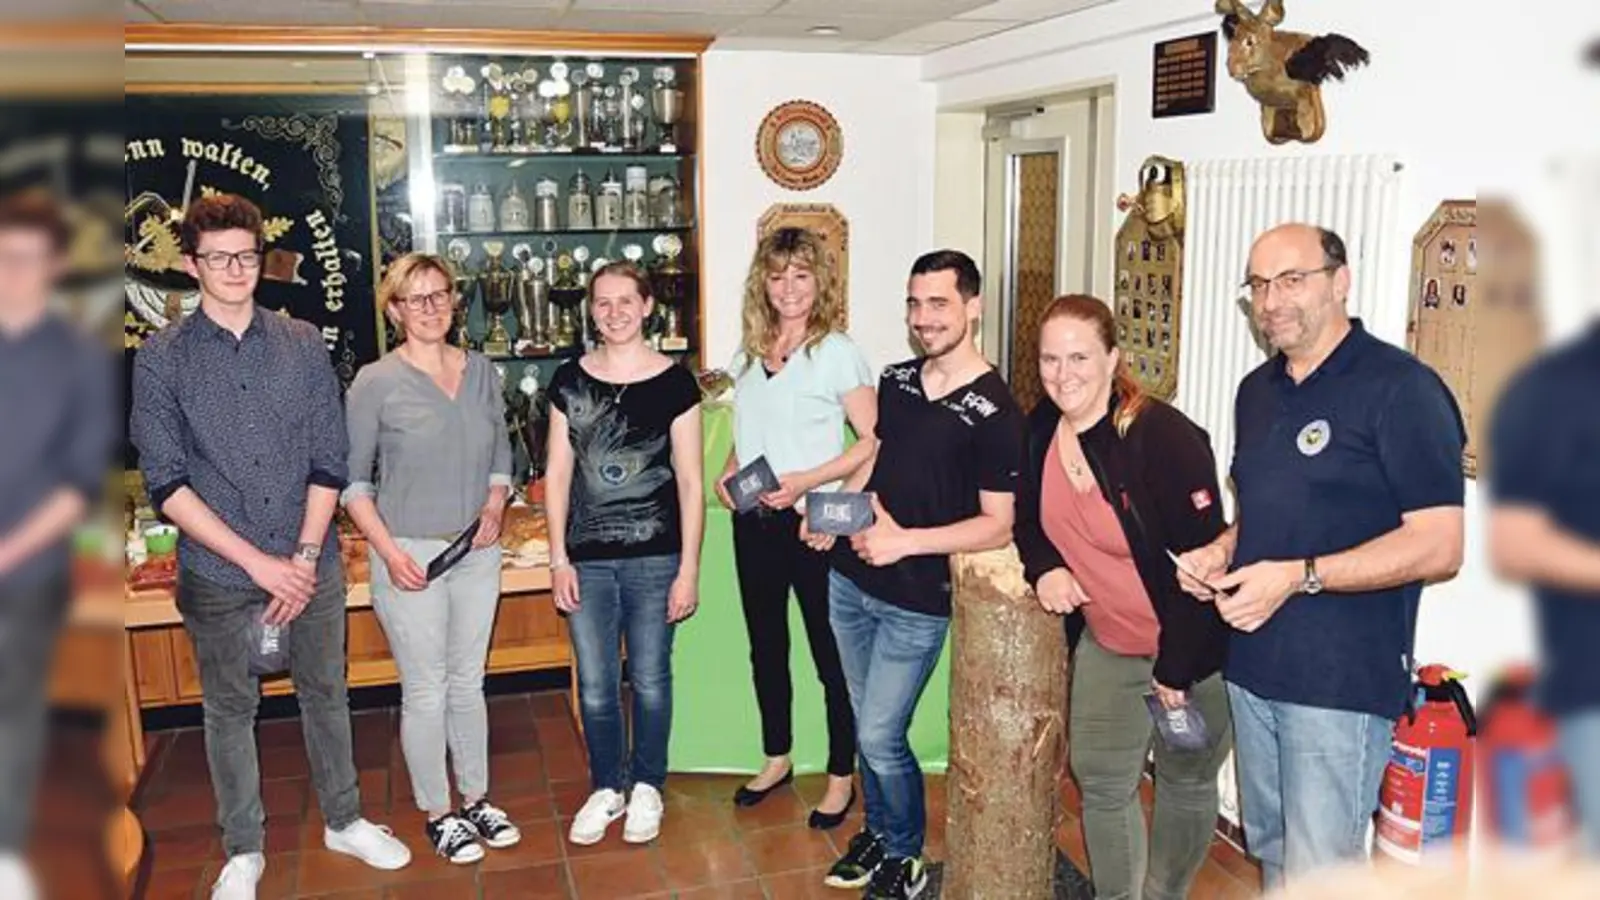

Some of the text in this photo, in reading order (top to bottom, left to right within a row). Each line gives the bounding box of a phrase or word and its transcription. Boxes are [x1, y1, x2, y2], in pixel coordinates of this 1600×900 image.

[125, 137, 271, 191] nn walten,
[304, 208, 348, 312] erhalten
